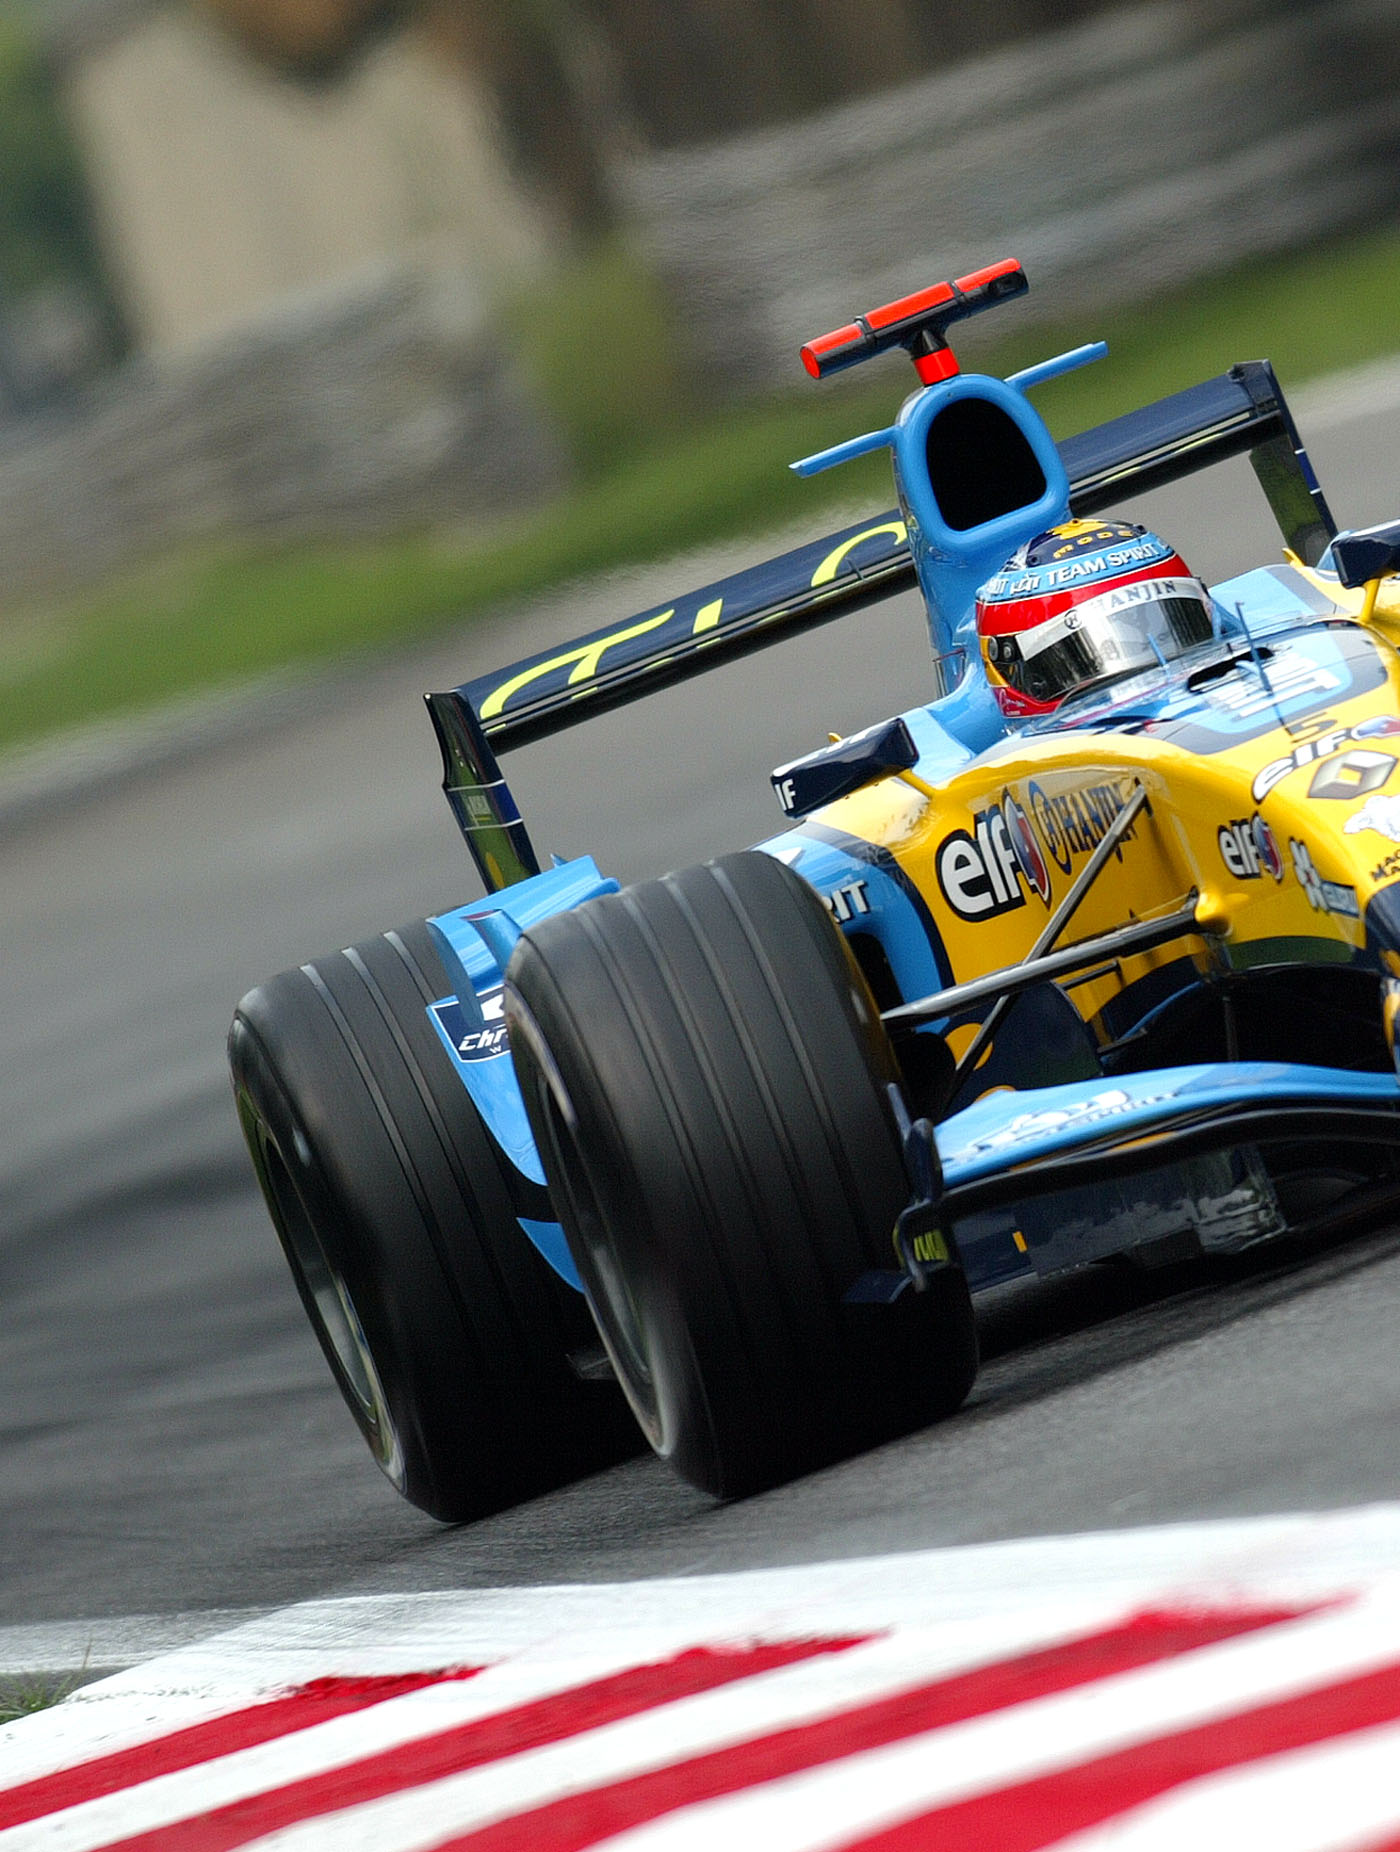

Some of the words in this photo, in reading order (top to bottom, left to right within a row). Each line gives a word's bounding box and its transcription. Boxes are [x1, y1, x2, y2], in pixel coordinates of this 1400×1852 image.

[1045, 556, 1108, 585] TEAM
[1108, 543, 1161, 568] SPIRIT
[1090, 579, 1177, 609] ANJIN
[1251, 727, 1353, 806] elf
[935, 803, 1025, 922] elf
[1217, 816, 1261, 881] elf
